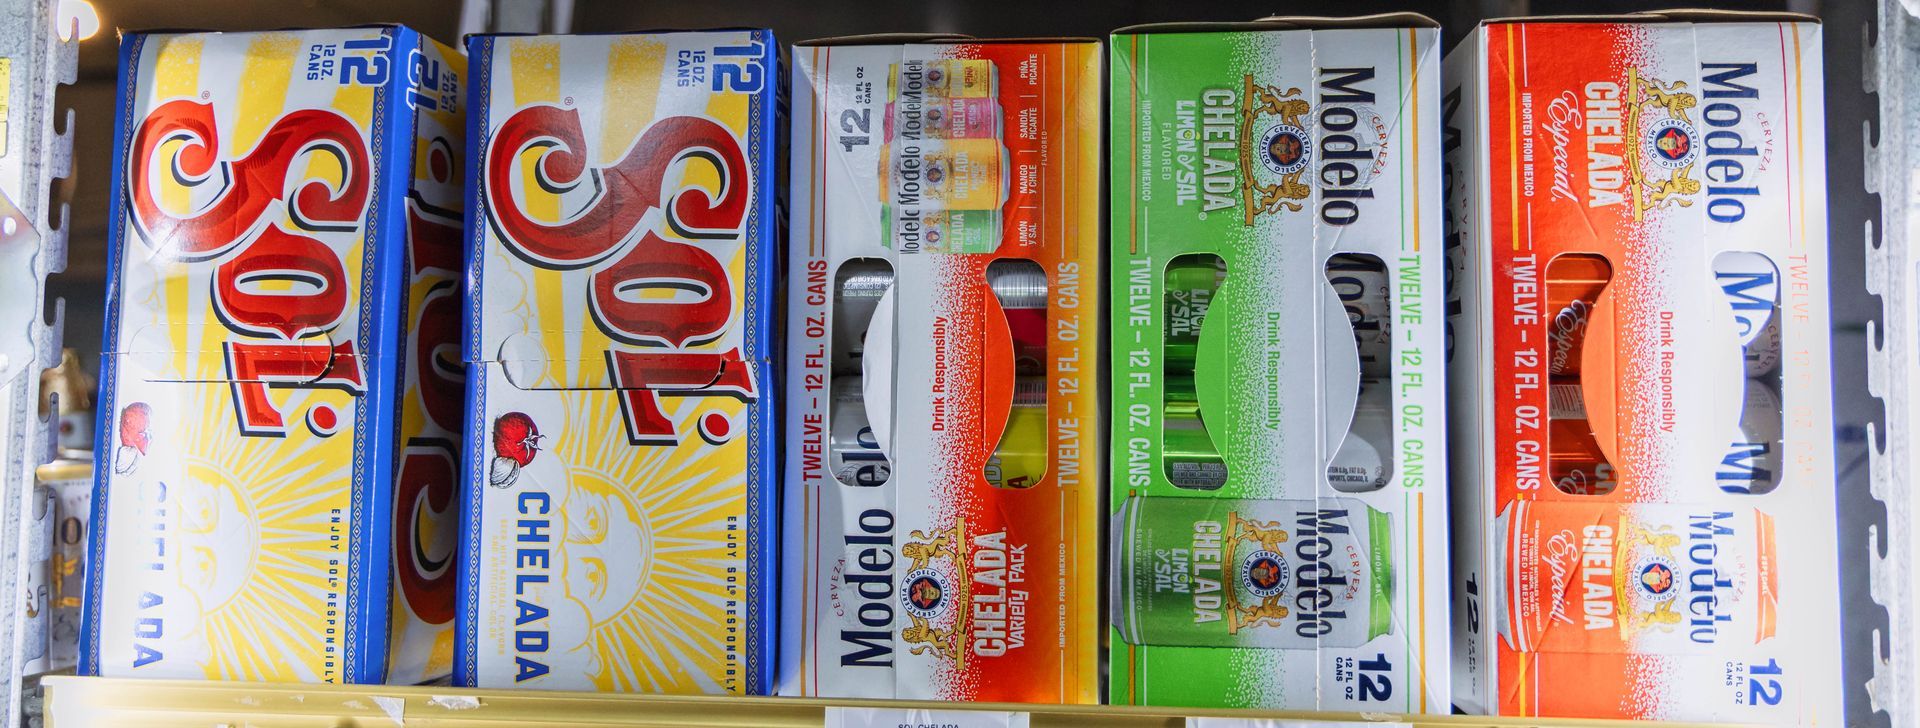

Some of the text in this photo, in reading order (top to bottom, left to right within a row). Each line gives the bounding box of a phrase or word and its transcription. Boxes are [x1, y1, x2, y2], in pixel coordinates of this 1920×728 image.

[307, 44, 323, 81] CANS
[321, 44, 336, 81] 12 OZ.
[339, 35, 392, 87] 12
[406, 48, 439, 112] 12
[677, 49, 692, 88] CANS
[691, 49, 706, 88] 12 OZ.
[712, 38, 766, 94] 12
[855, 66, 864, 104] 12 FL OZ
[1018, 60, 1028, 79] PIÑA
[1028, 54, 1038, 85] PICANTE
[449, 71, 458, 113] CANS
[864, 82, 872, 104] CANS
[840, 108, 871, 153] 12
[1028, 107, 1038, 140] PICANTE
[1319, 66, 1376, 226] Modelo
[1371, 115, 1388, 176] CERVEZA
[1522, 92, 1535, 197] IMPORTED FROM MEXICO
[1585, 81, 1625, 209] CHELADA
[1700, 61, 1761, 224] Modelo
[1756, 111, 1777, 173] CERVEZA
[898, 145, 921, 205] Modelo
[1028, 164, 1037, 187] CHILE
[1141, 100, 1152, 201] IMPORTED FROM MEXICO
[1162, 122, 1172, 181] FLAVORED
[1202, 88, 1237, 213] CHELADA
[1019, 164, 1028, 194] MANGO
[1176, 170, 1198, 206] SAL
[1018, 220, 1028, 247] LIMÓN
[1028, 222, 1037, 239] SAL
[807, 259, 829, 307] CANS
[1057, 261, 1080, 309] CANS
[1129, 257, 1152, 327] TWELVE
[1399, 255, 1422, 325] TWELVE
[1512, 254, 1538, 326] TWELVE
[932, 316, 949, 432] Drink Responsibly
[1129, 348, 1151, 368] 12
[1266, 312, 1282, 431] Drink Responsibly
[1401, 347, 1422, 366] 12
[1513, 347, 1539, 368] 12
[1660, 311, 1675, 433] Drink Responsibly
[805, 374, 824, 393] 12
[1058, 377, 1080, 397] 12
[803, 413, 823, 482] TWELVE
[1057, 416, 1080, 488] TWELVE
[1128, 437, 1151, 488] CANS
[1402, 438, 1425, 490] CANS
[1515, 439, 1541, 492] CANS
[330, 508, 341, 551] ENJOY
[726, 515, 738, 559] ENJOY
[1521, 533, 1529, 569] BREWED
[514, 490, 552, 684] CHELADA
[830, 557, 846, 618] CERVEZA
[840, 508, 895, 669] Modelo
[1008, 544, 1028, 583] PACK
[1155, 562, 1172, 593] SAL
[1192, 520, 1222, 625] CHELADA
[1295, 508, 1349, 639] Modelo
[1346, 544, 1361, 601] CERVEZA
[1582, 523, 1615, 631] CHELADA
[973, 531, 1006, 658] CHELADA
[1521, 583, 1530, 617] MEXICO
[325, 592, 337, 685] RESPONSIBLY
[724, 599, 737, 693] RESPONSIBLY
[1335, 656, 1343, 682] CANS
[1344, 656, 1353, 701] 12 FL OZ
[1358, 652, 1393, 702] 12
[1725, 661, 1733, 687] CANS
[1735, 661, 1743, 705] 12 FL OZ
[1749, 657, 1783, 706] 12
